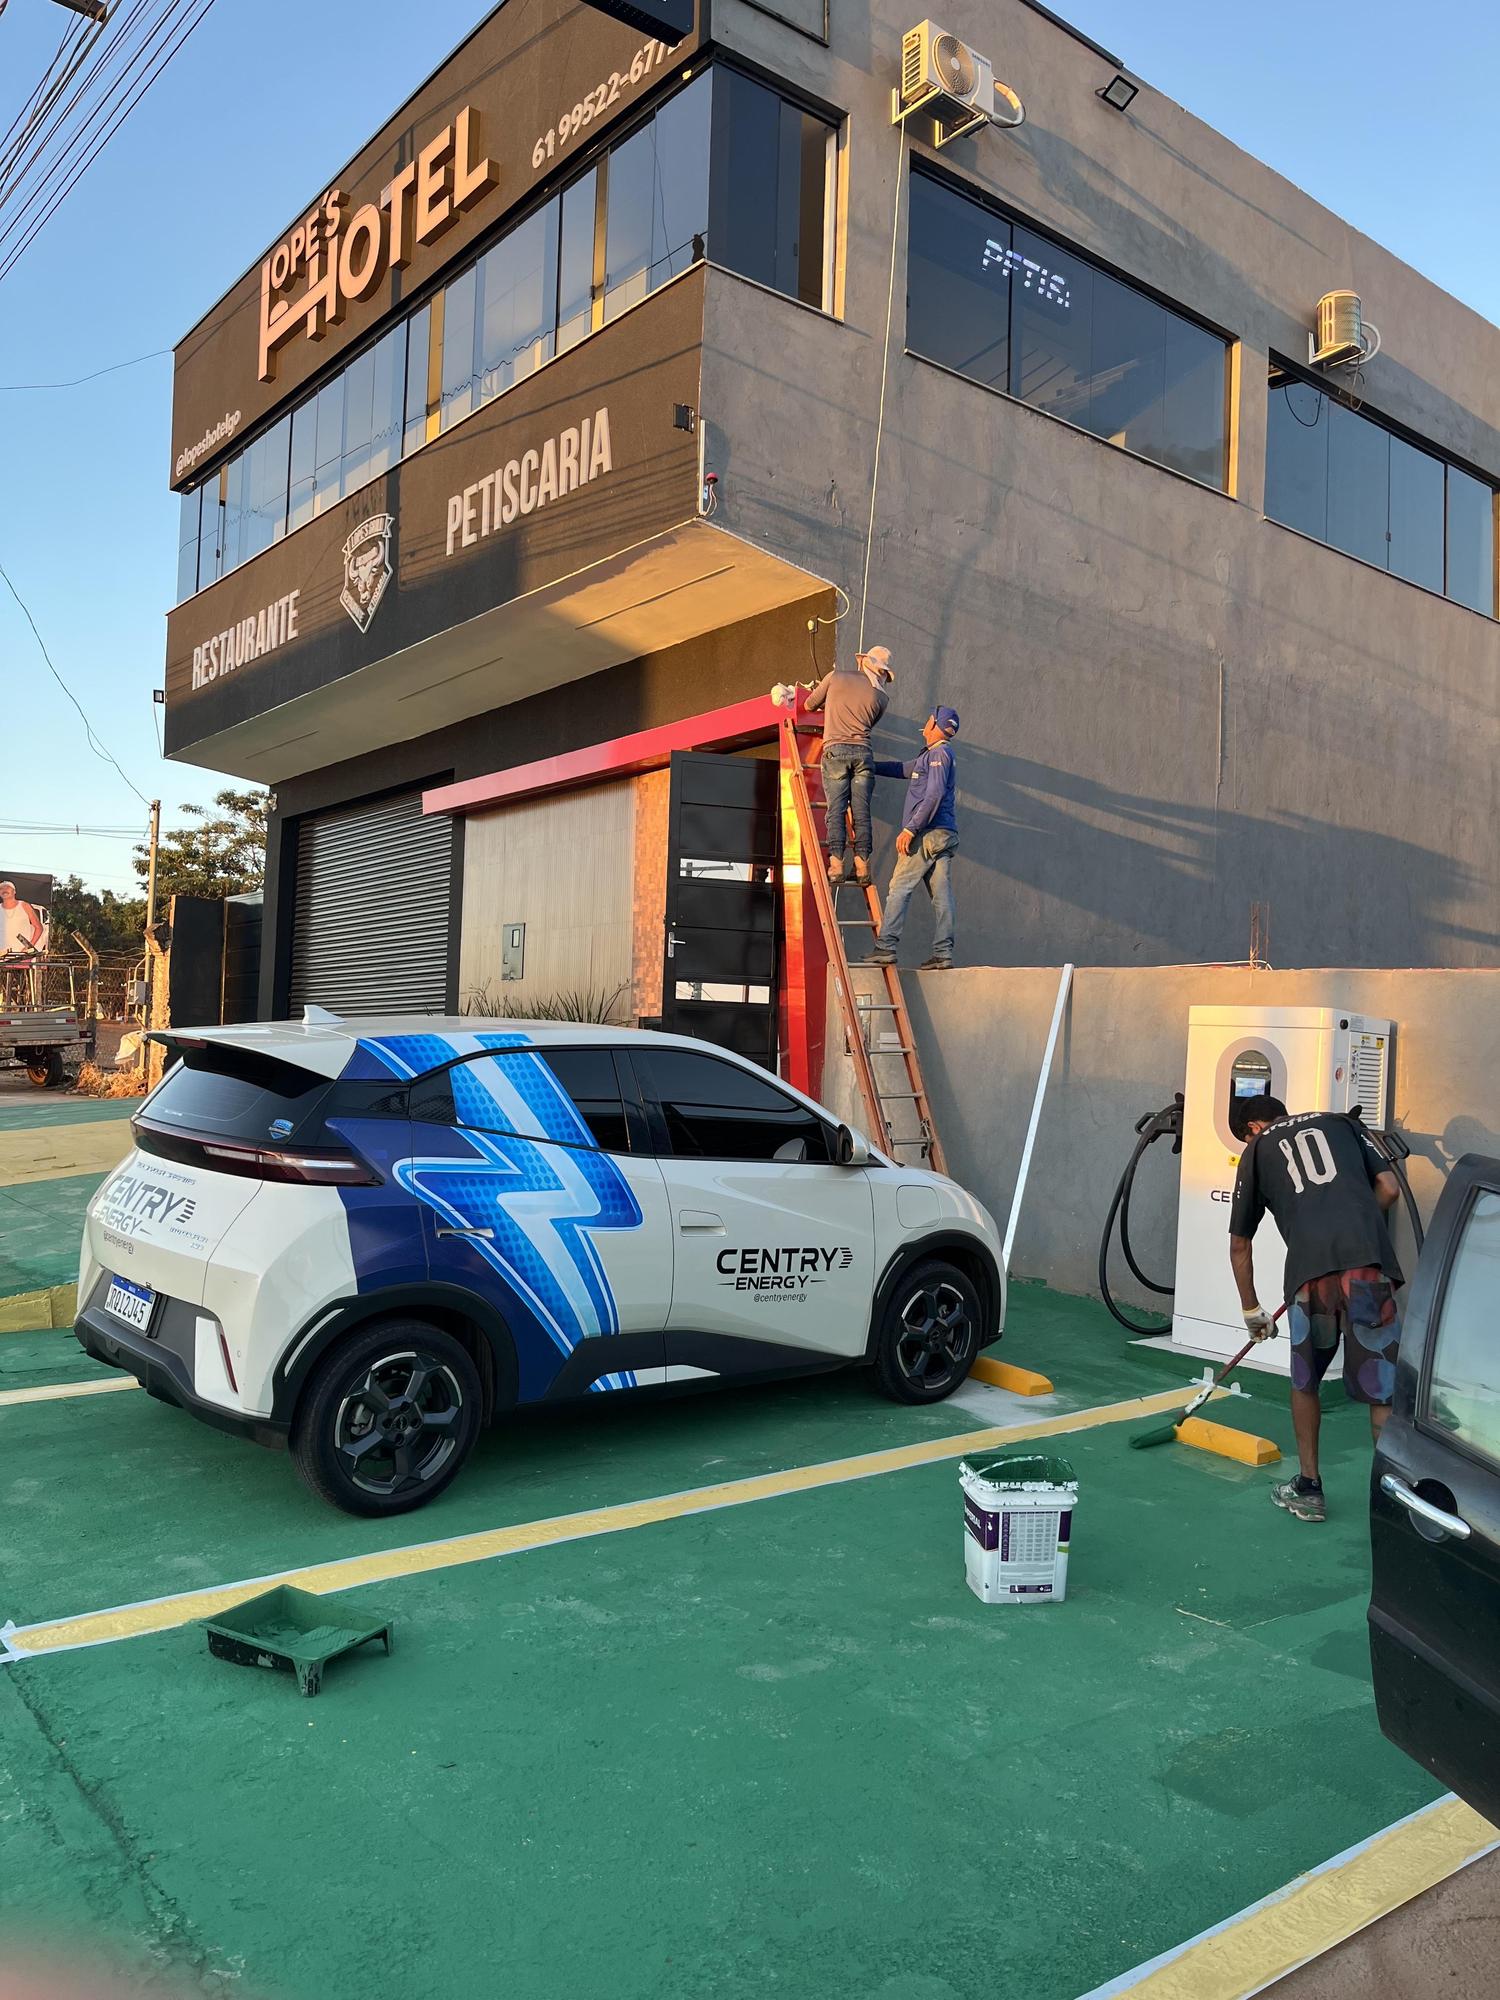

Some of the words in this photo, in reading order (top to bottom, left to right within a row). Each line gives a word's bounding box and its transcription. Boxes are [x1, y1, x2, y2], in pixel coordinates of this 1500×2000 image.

[532, 128, 556, 169] 61
[306, 105, 490, 341] HOTEL
[176, 410, 242, 477] @lopeshotelgo
[446, 407, 613, 556] PETISCARIA
[192, 588, 301, 691] RESTAURANTE
[1278, 1127, 1338, 1194] 10
[99, 1205, 143, 1236] ENERGY
[102, 1174, 187, 1224] CENTRY
[716, 1247, 839, 1275] CENTRY
[735, 1275, 810, 1291] ENERGY
[753, 1293, 808, 1303] @centryenergy
